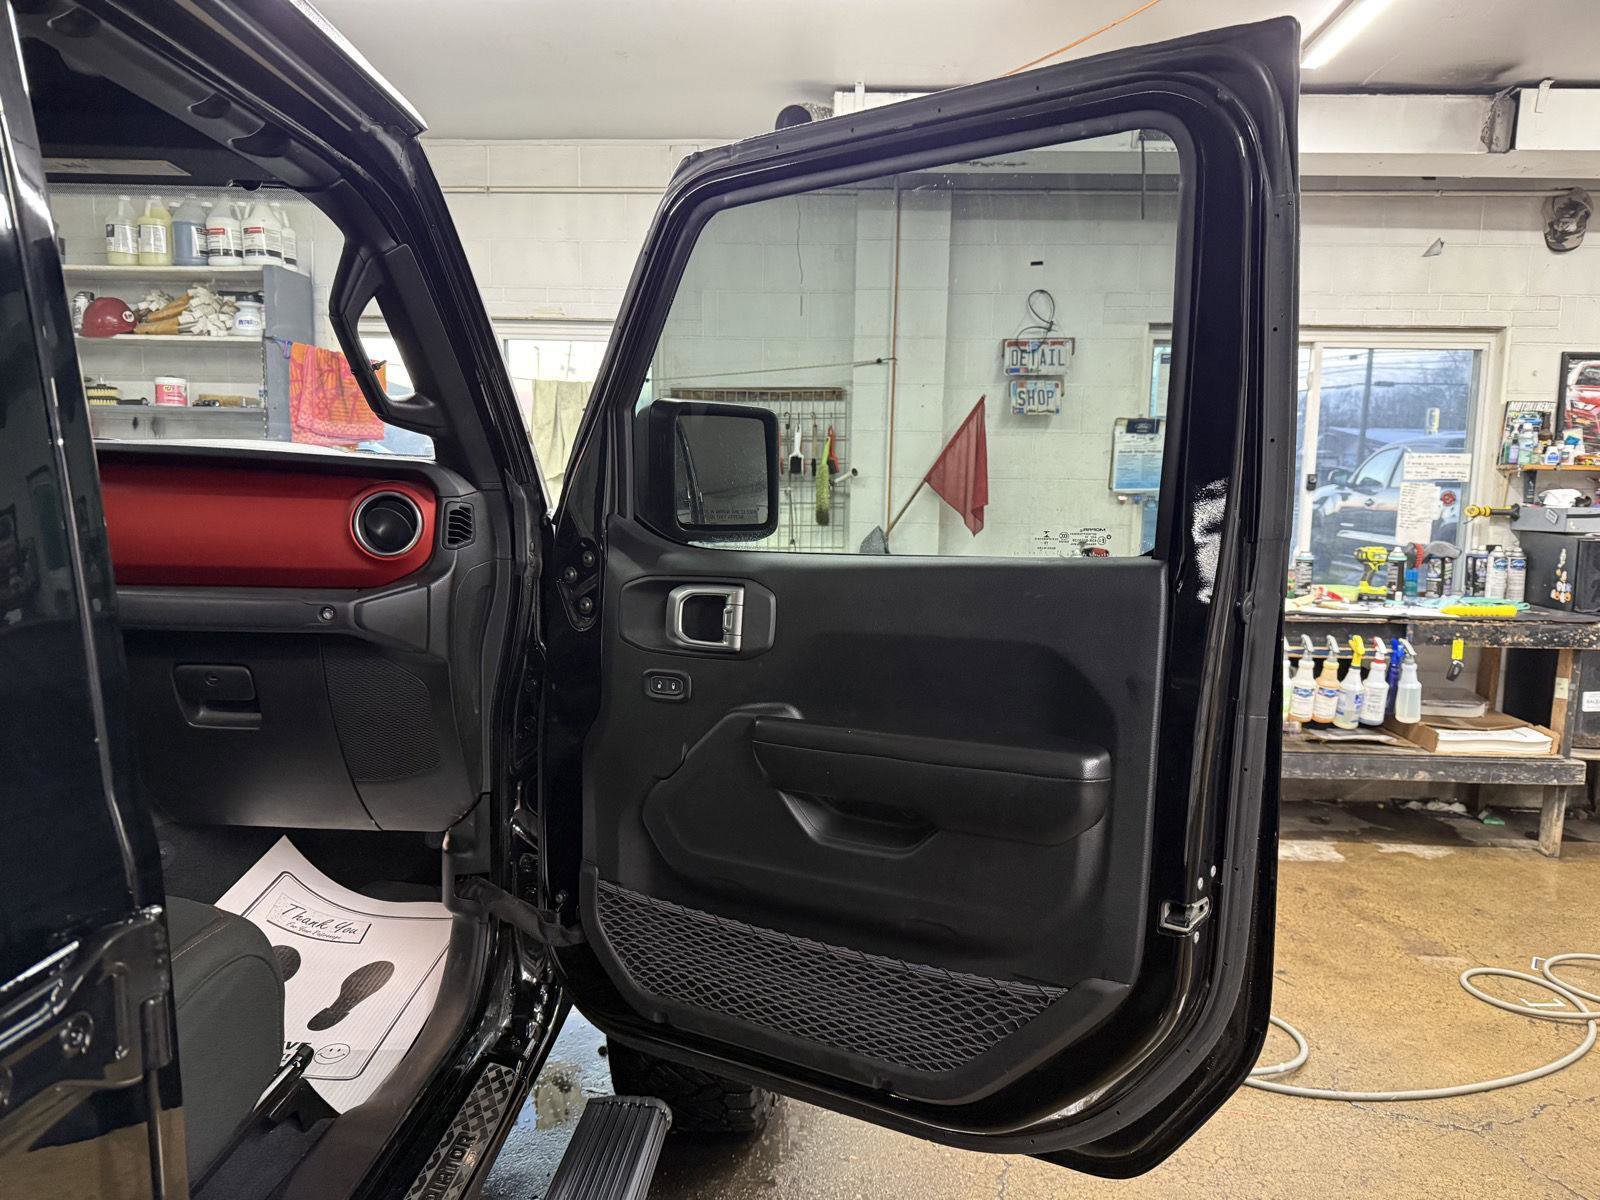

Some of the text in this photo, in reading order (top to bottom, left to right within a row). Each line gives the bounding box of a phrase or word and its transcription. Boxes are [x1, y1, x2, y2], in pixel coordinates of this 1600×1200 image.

[1011, 348, 1065, 366] DETAIL
[1017, 389, 1055, 406] SHOP
[282, 904, 359, 934] Thank You
